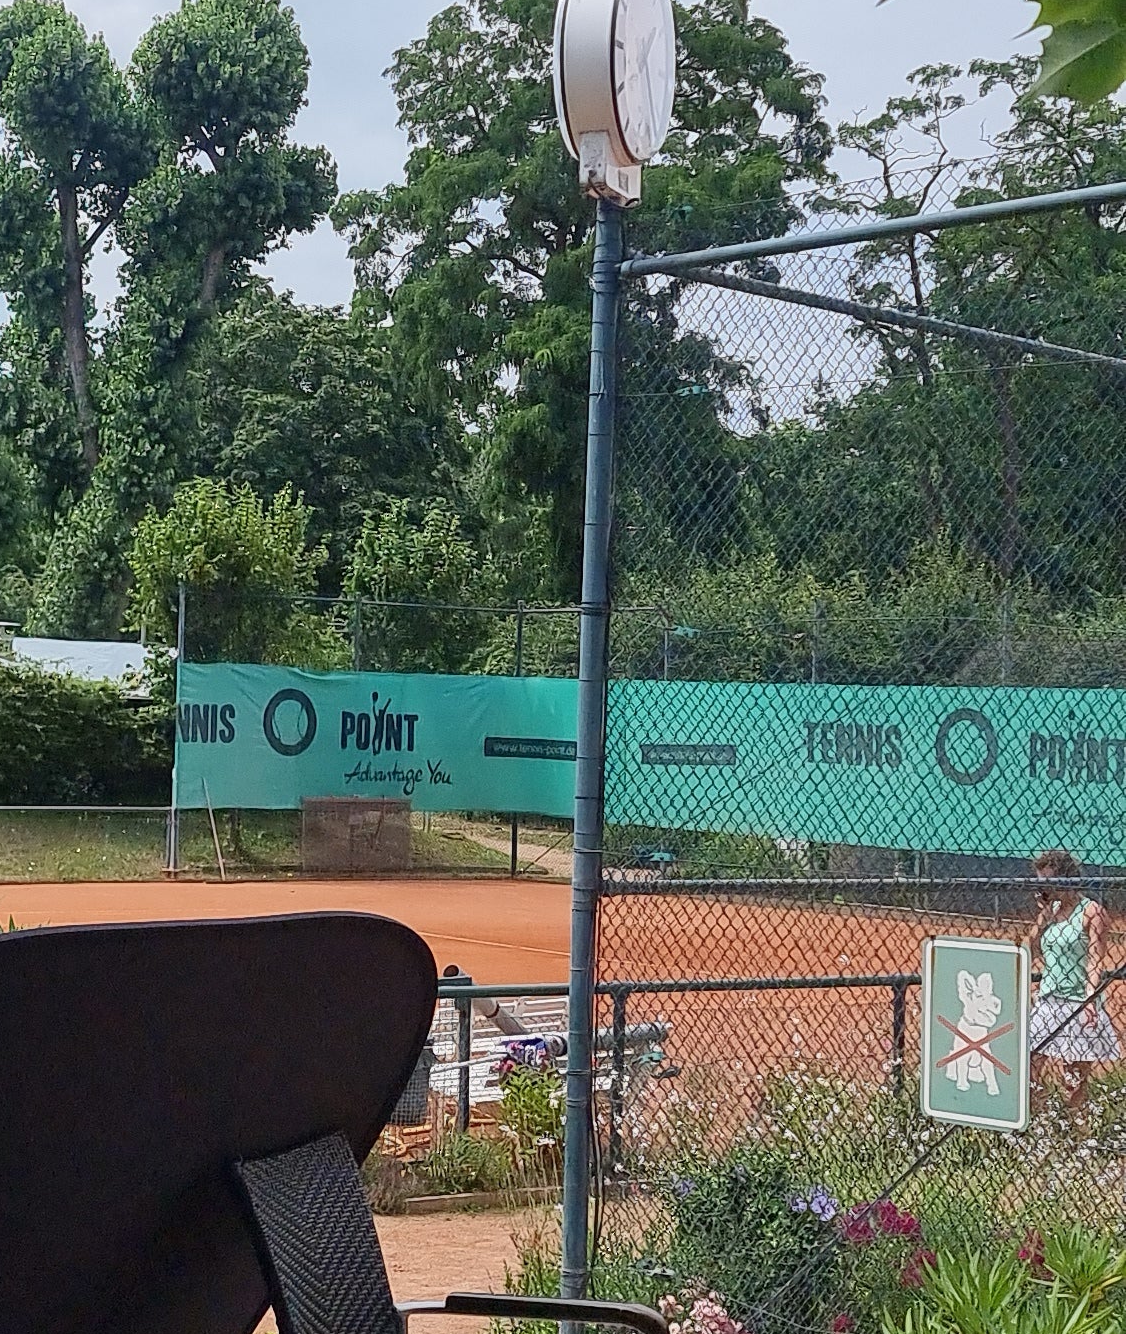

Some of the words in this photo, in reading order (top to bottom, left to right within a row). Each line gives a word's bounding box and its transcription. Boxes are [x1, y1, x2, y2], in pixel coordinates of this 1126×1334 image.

[340, 691, 419, 756] POINT
[803, 721, 903, 768] TENNIS
[344, 760, 423, 796] Advantage
[426, 759, 452, 785] You
